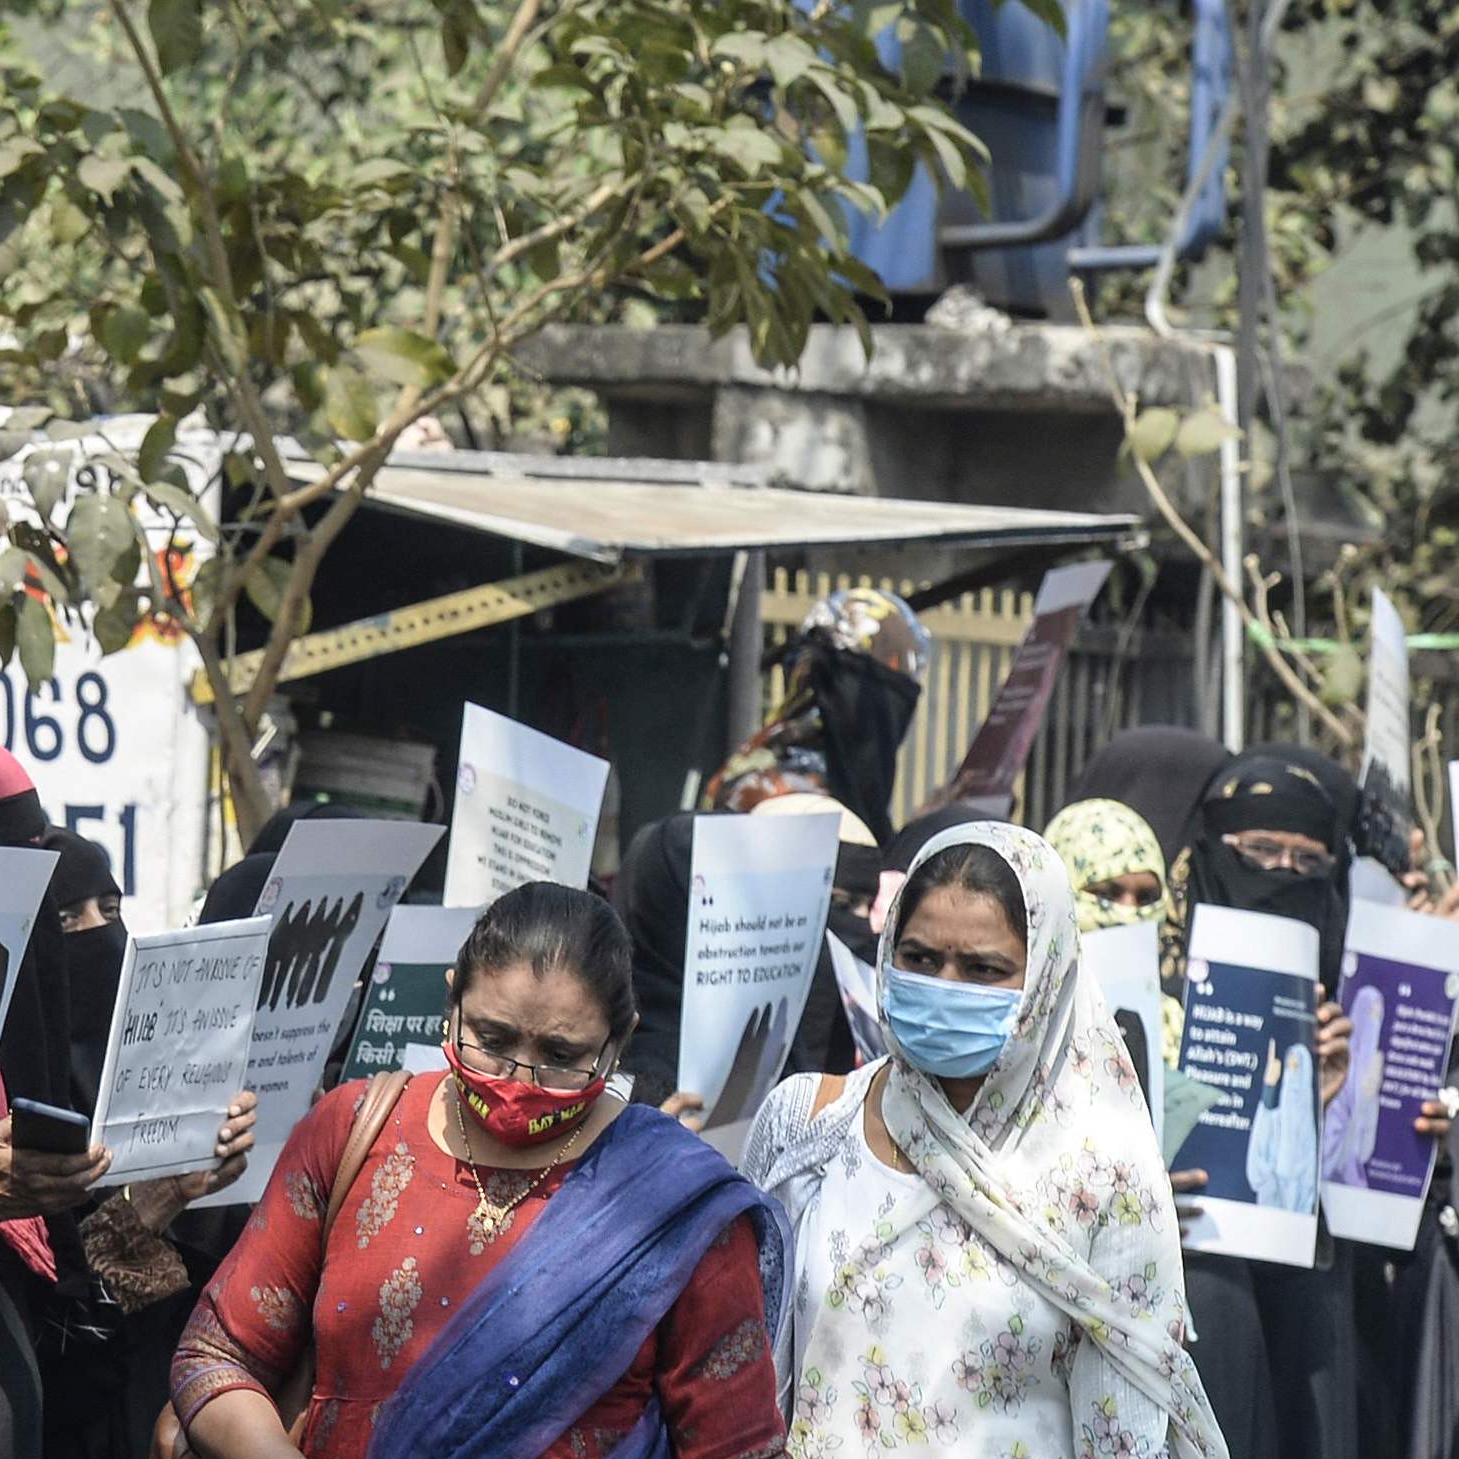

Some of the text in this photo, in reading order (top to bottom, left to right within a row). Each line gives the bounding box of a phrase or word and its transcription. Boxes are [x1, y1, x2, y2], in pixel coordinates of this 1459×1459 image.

[699, 916, 731, 935] Hijab
[735, 914, 767, 932] should
[697, 943, 757, 960] obstruction
[168, 958, 194, 985] NOT
[243, 955, 261, 980] OF
[696, 961, 802, 986] RIGHT TO EDUCATION
[366, 1008, 443, 1036] शिक्षा पर हर
[258, 1051, 276, 1068] and
[356, 1042, 395, 1066] किसी
[116, 1068, 132, 1093] OF
[138, 1064, 174, 1090] EVERY
